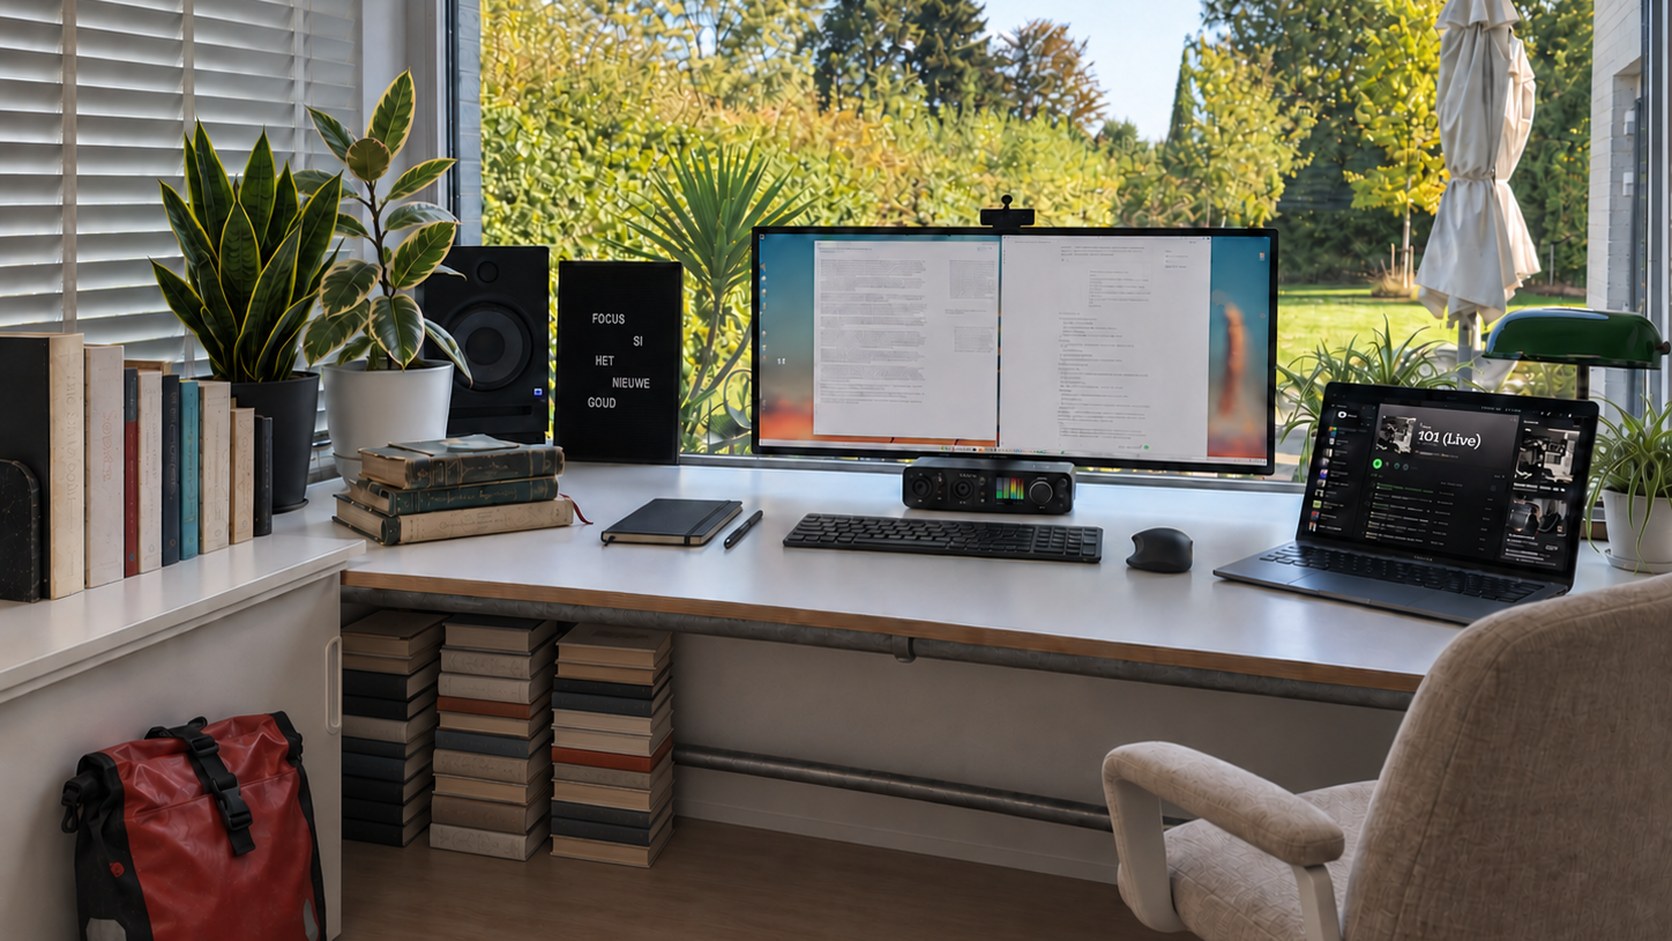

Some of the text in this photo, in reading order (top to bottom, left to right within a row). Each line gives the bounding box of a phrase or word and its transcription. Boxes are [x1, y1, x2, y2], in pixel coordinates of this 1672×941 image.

[592, 313, 625, 324] FOCUS
[633, 336, 643, 346] SI
[595, 356, 614, 366] HET
[612, 377, 650, 388] NIEUWE
[588, 396, 616, 408] GOUD
[1418, 431, 1481, 450] 101 (Live)
